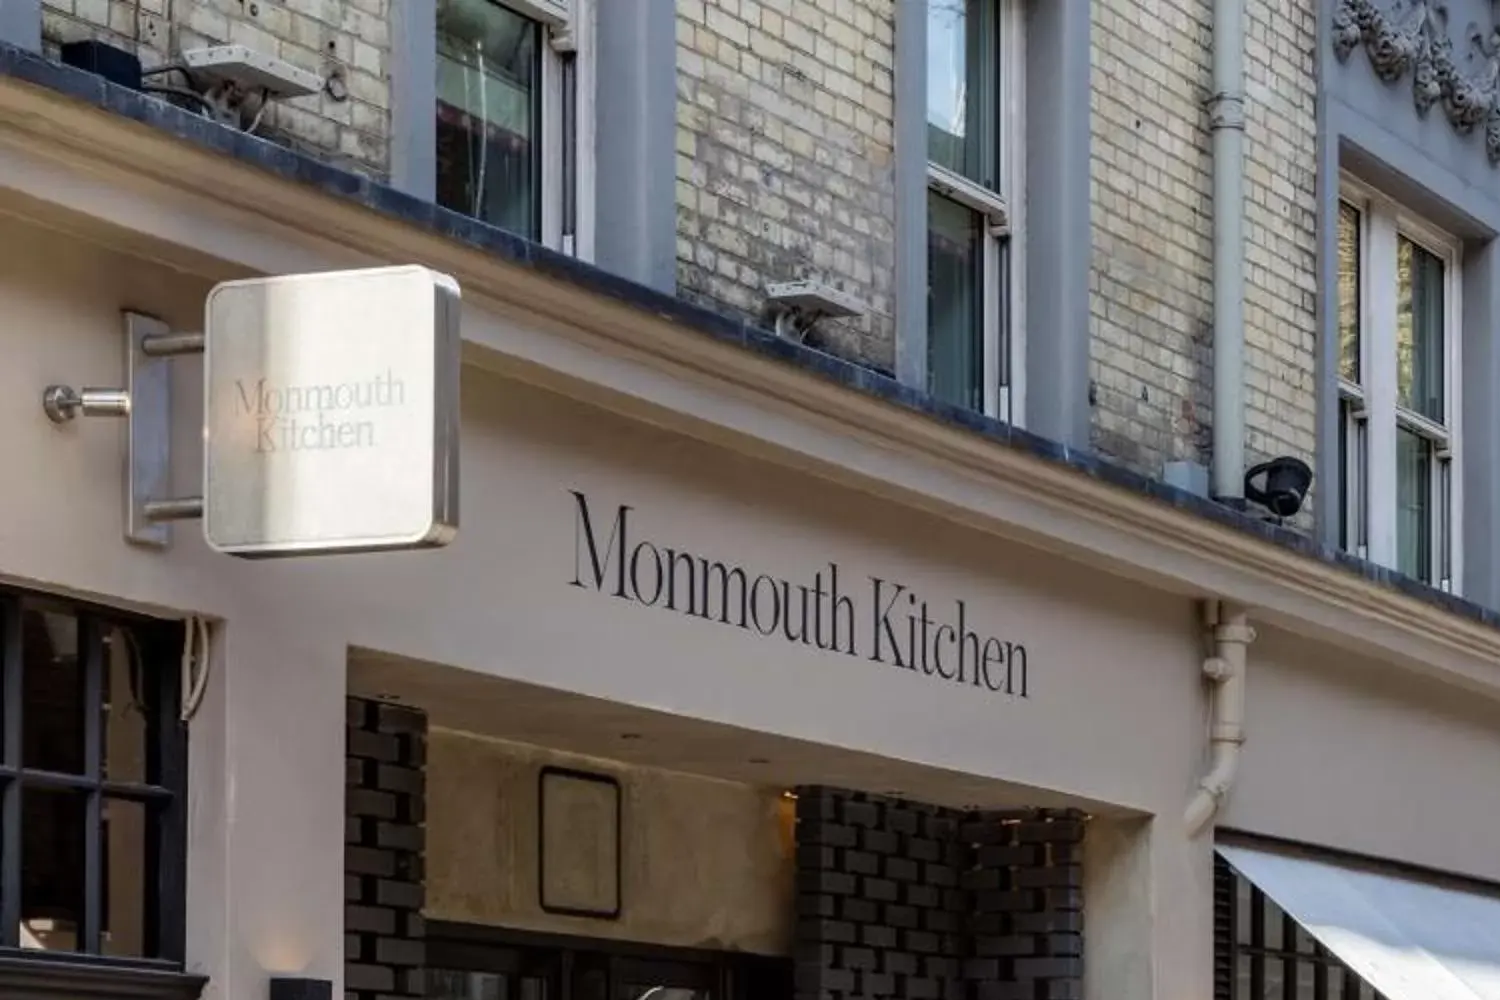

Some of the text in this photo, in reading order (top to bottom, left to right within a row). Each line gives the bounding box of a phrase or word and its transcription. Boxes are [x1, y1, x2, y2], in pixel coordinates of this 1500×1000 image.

[233, 366, 405, 417] Monmouth
[254, 411, 375, 453] Kitchen
[567, 489, 1030, 698] Monmouth Kitchen
